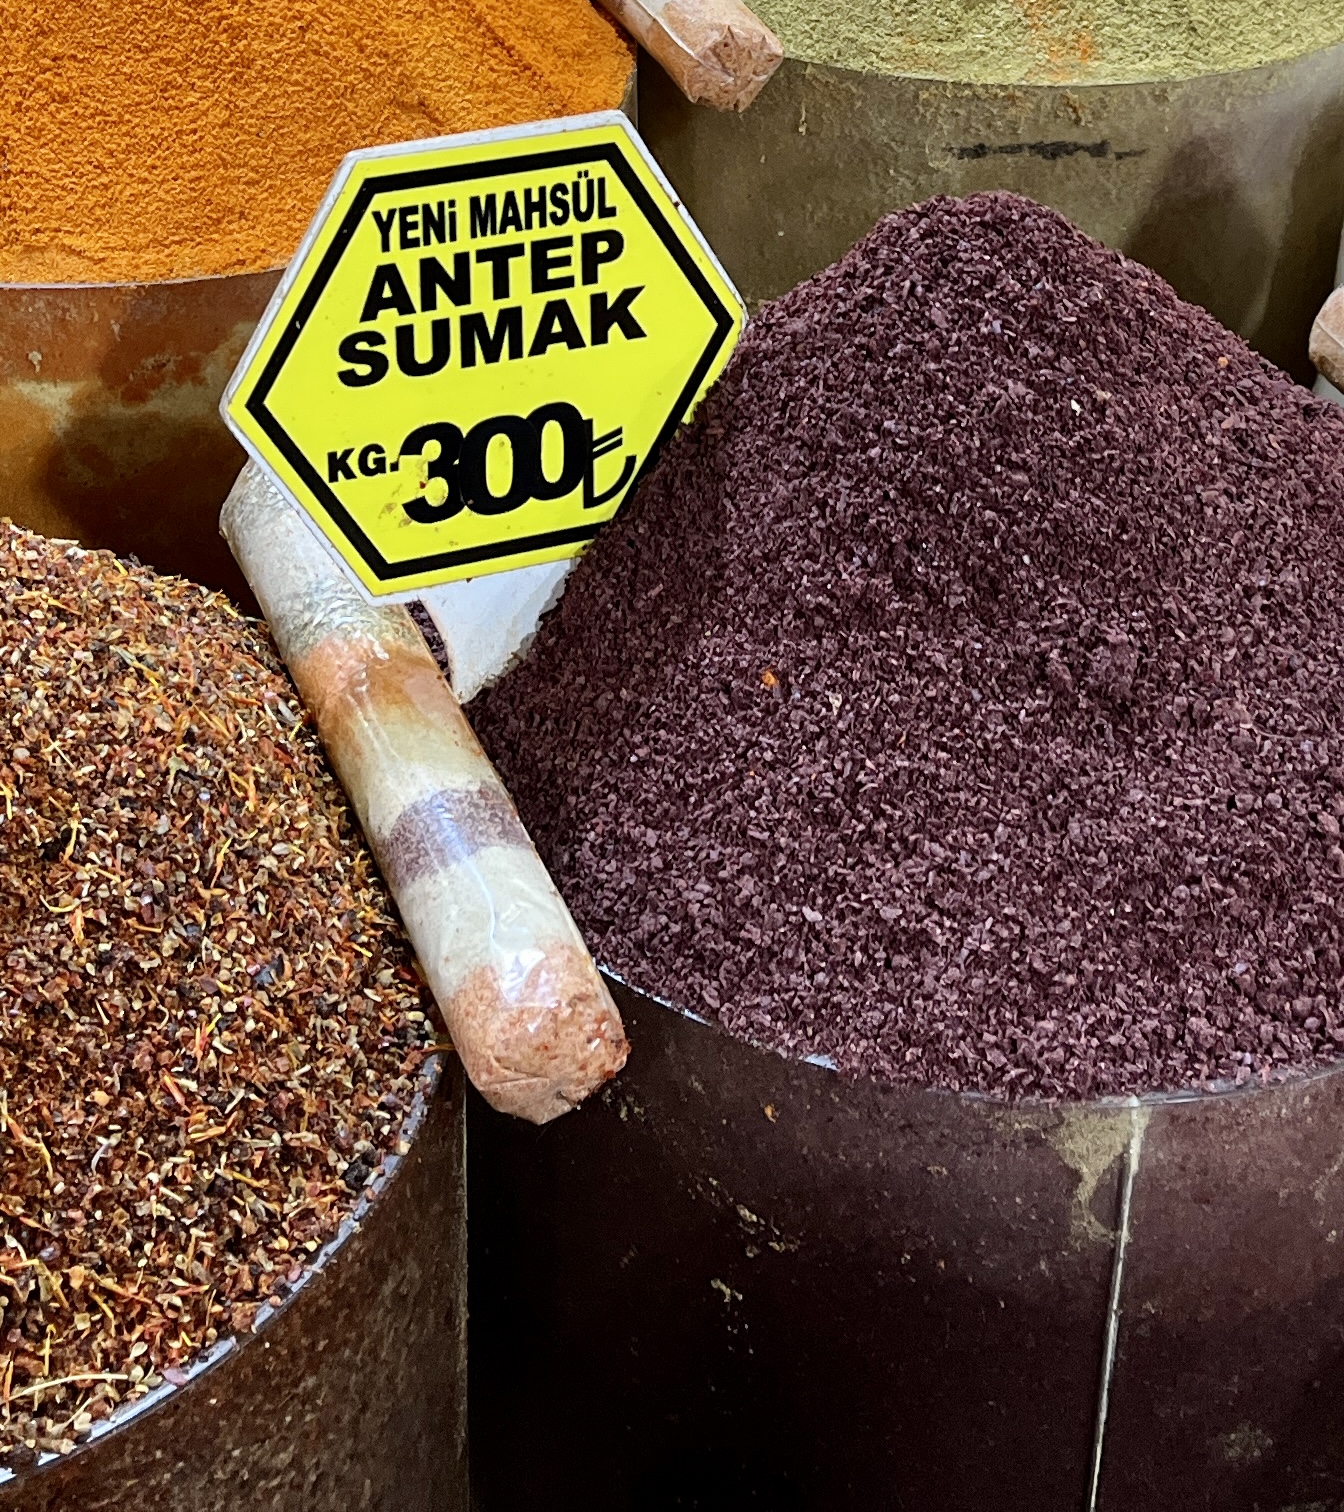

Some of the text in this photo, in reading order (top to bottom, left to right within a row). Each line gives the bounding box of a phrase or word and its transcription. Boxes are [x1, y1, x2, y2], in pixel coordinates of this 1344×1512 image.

[469, 170, 617, 240] MAHSÜL
[359, 229, 625, 323] ANTEP
[337, 285, 647, 389] SUMAK
